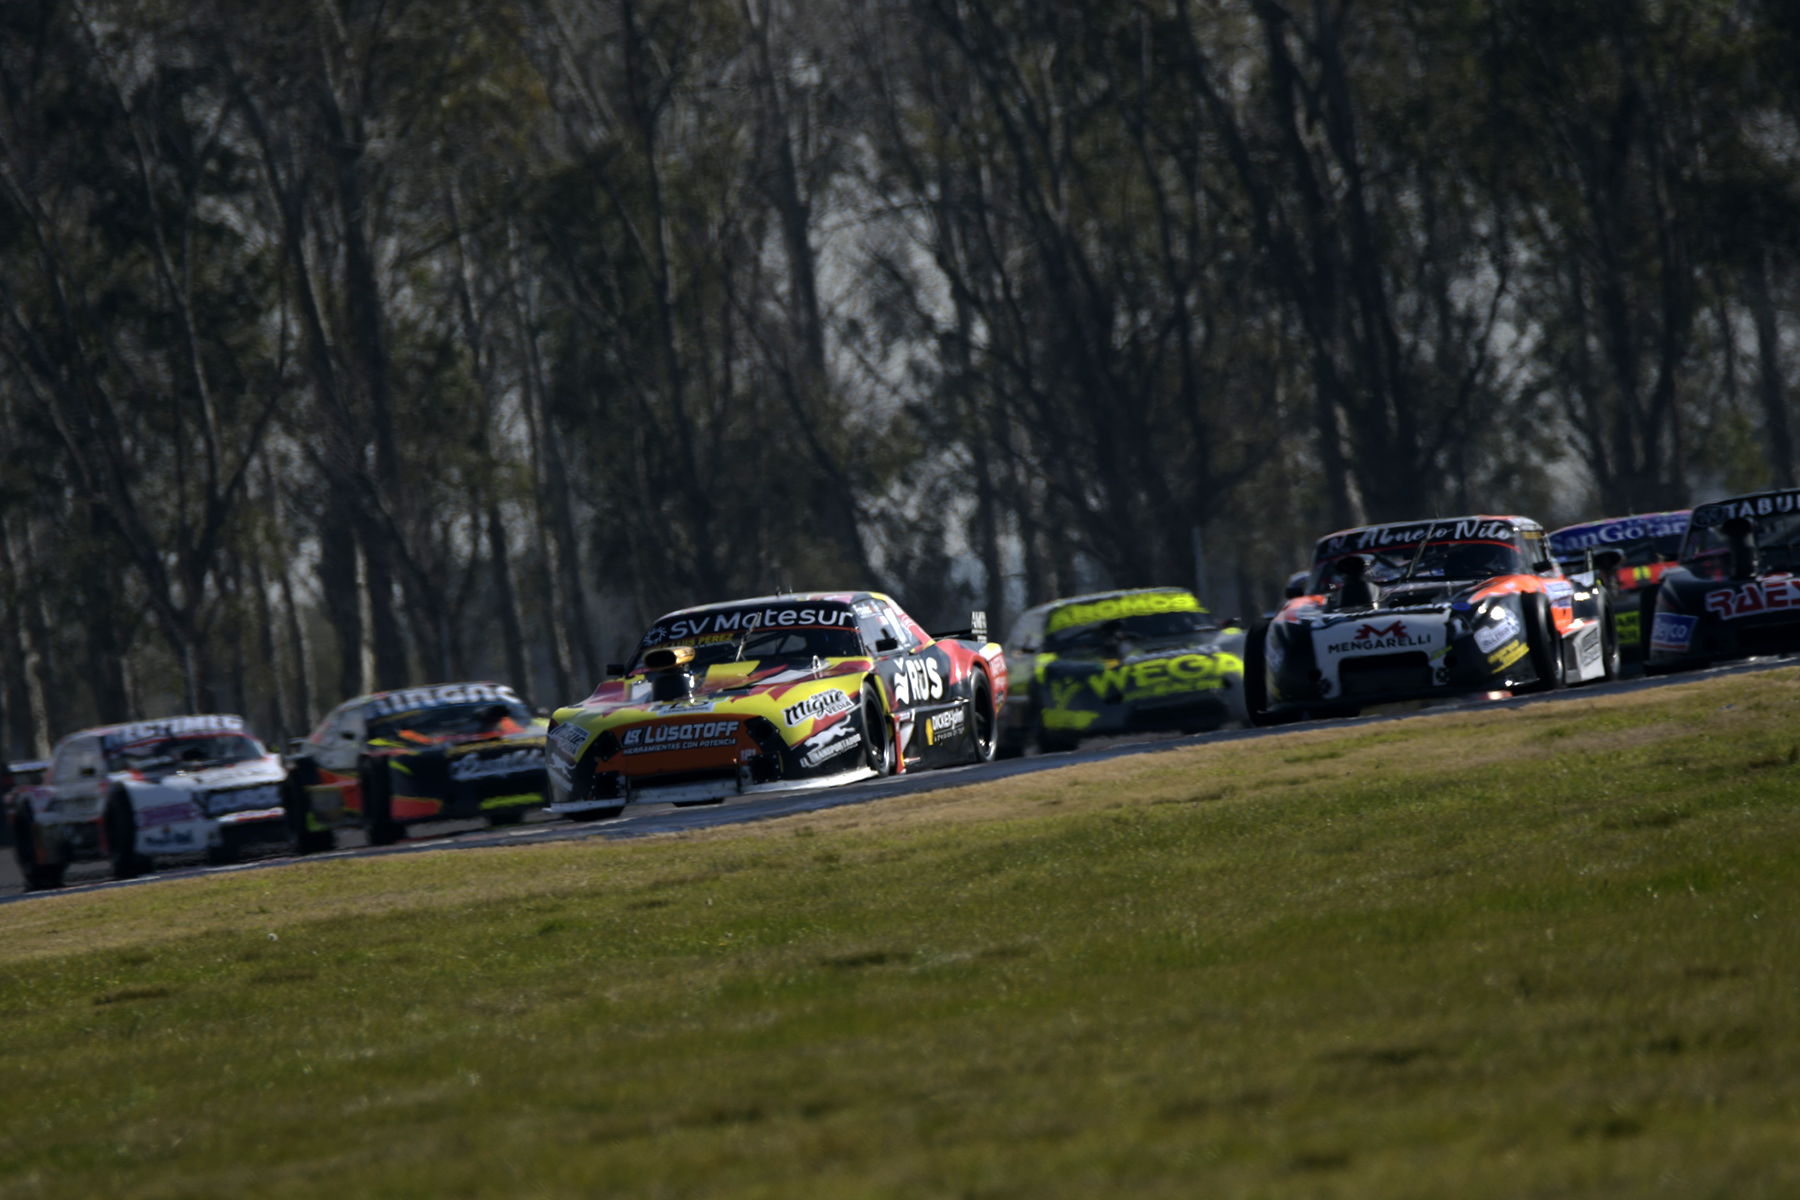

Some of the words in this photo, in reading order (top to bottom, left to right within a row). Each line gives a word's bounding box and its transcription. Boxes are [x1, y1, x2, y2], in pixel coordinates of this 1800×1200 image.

[1721, 493, 1800, 519] TABU
[1454, 520, 1514, 541] Nito
[668, 617, 710, 640] SV
[713, 608, 853, 632] Matesur
[698, 633, 735, 646] PEREZ
[1328, 633, 1432, 653] MENGARELLI
[784, 690, 843, 725] Migue
[825, 701, 852, 714] VEDIA
[622, 742, 680, 756] HERRAMIENTAS
[682, 741, 698, 750] CON
[699, 738, 736, 748] POTENCIA
